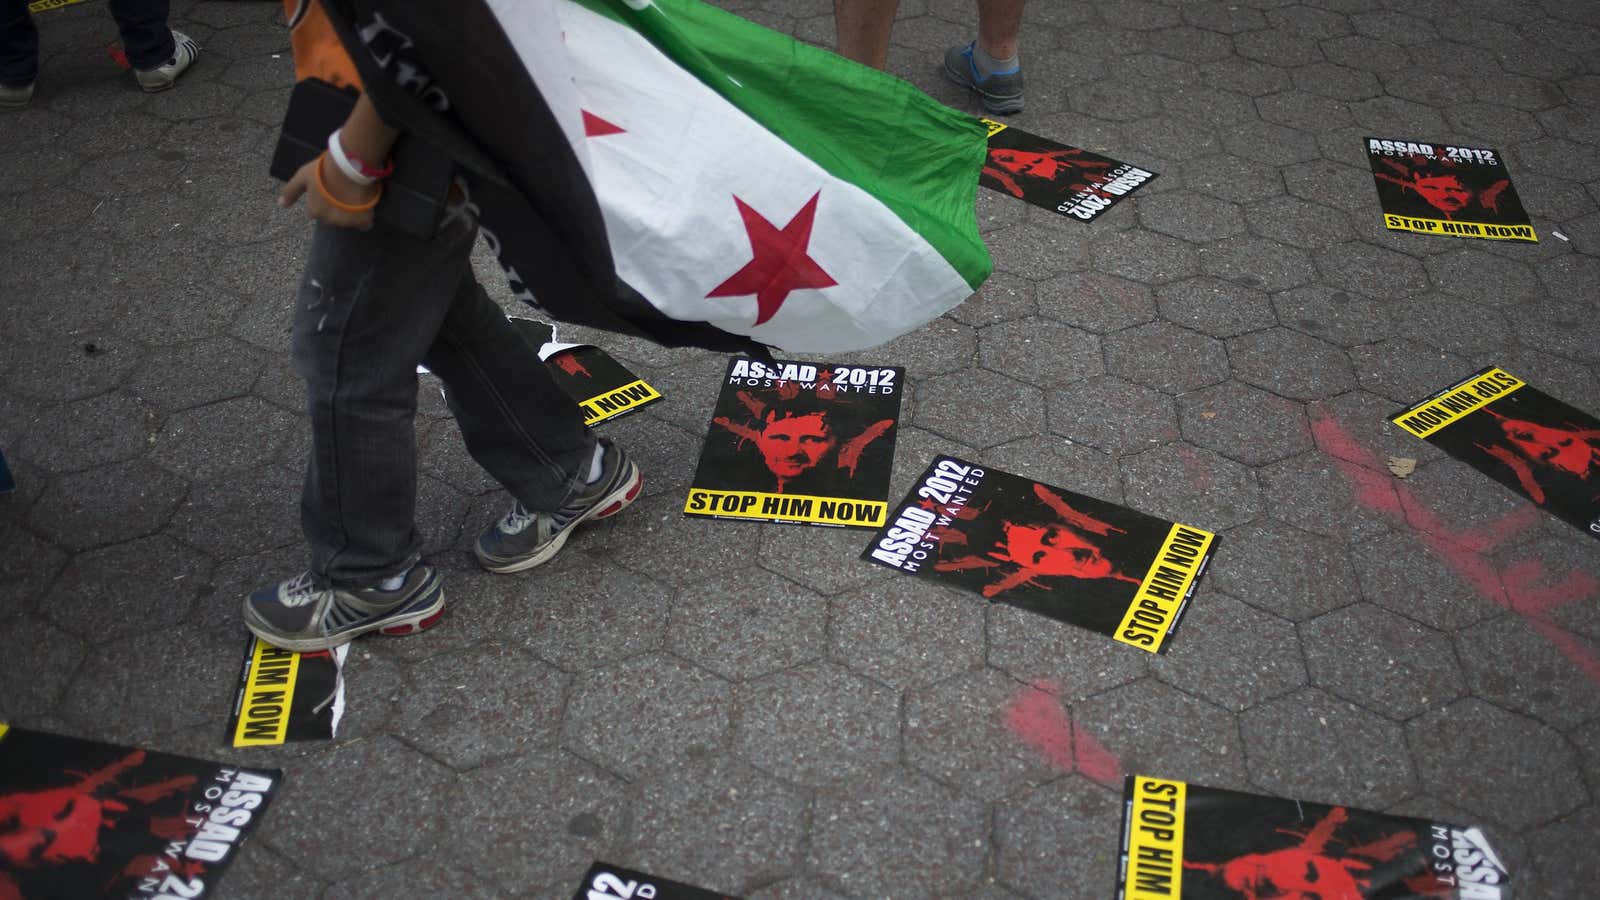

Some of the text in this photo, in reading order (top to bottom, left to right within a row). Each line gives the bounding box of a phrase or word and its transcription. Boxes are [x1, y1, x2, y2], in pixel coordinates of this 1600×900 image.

[1370, 139, 1495, 161] ASSAD 2012
[1371, 150, 1497, 166] MOST WANTED
[1057, 164, 1132, 212] MOST WANTED
[1066, 167, 1153, 219] ASSAD 2012
[1388, 216, 1437, 231] STOP
[1442, 223, 1481, 235] HIM
[1485, 226, 1532, 238] NOW
[729, 377, 893, 396] MOST WANTED
[832, 367, 896, 387] 2012
[1472, 373, 1518, 398] STOP
[594, 383, 651, 414] NOW
[1438, 390, 1483, 414] HIM
[1402, 405, 1453, 434] NOW
[690, 492, 757, 513] STOP
[761, 497, 812, 518] HIM
[818, 501, 882, 522] NOW
[872, 460, 970, 568] ASSAD 2012
[903, 468, 985, 572] MOST WANTED
[1163, 527, 1206, 569] NOW
[1145, 565, 1188, 602] HIM
[1123, 599, 1169, 646] STOP
[243, 690, 286, 739] NOW
[129, 769, 236, 900] MOST WAN
[185, 772, 273, 862] ASSAD
[1135, 782, 1177, 895] STOP HIM
[1431, 825, 1455, 887] MOST
